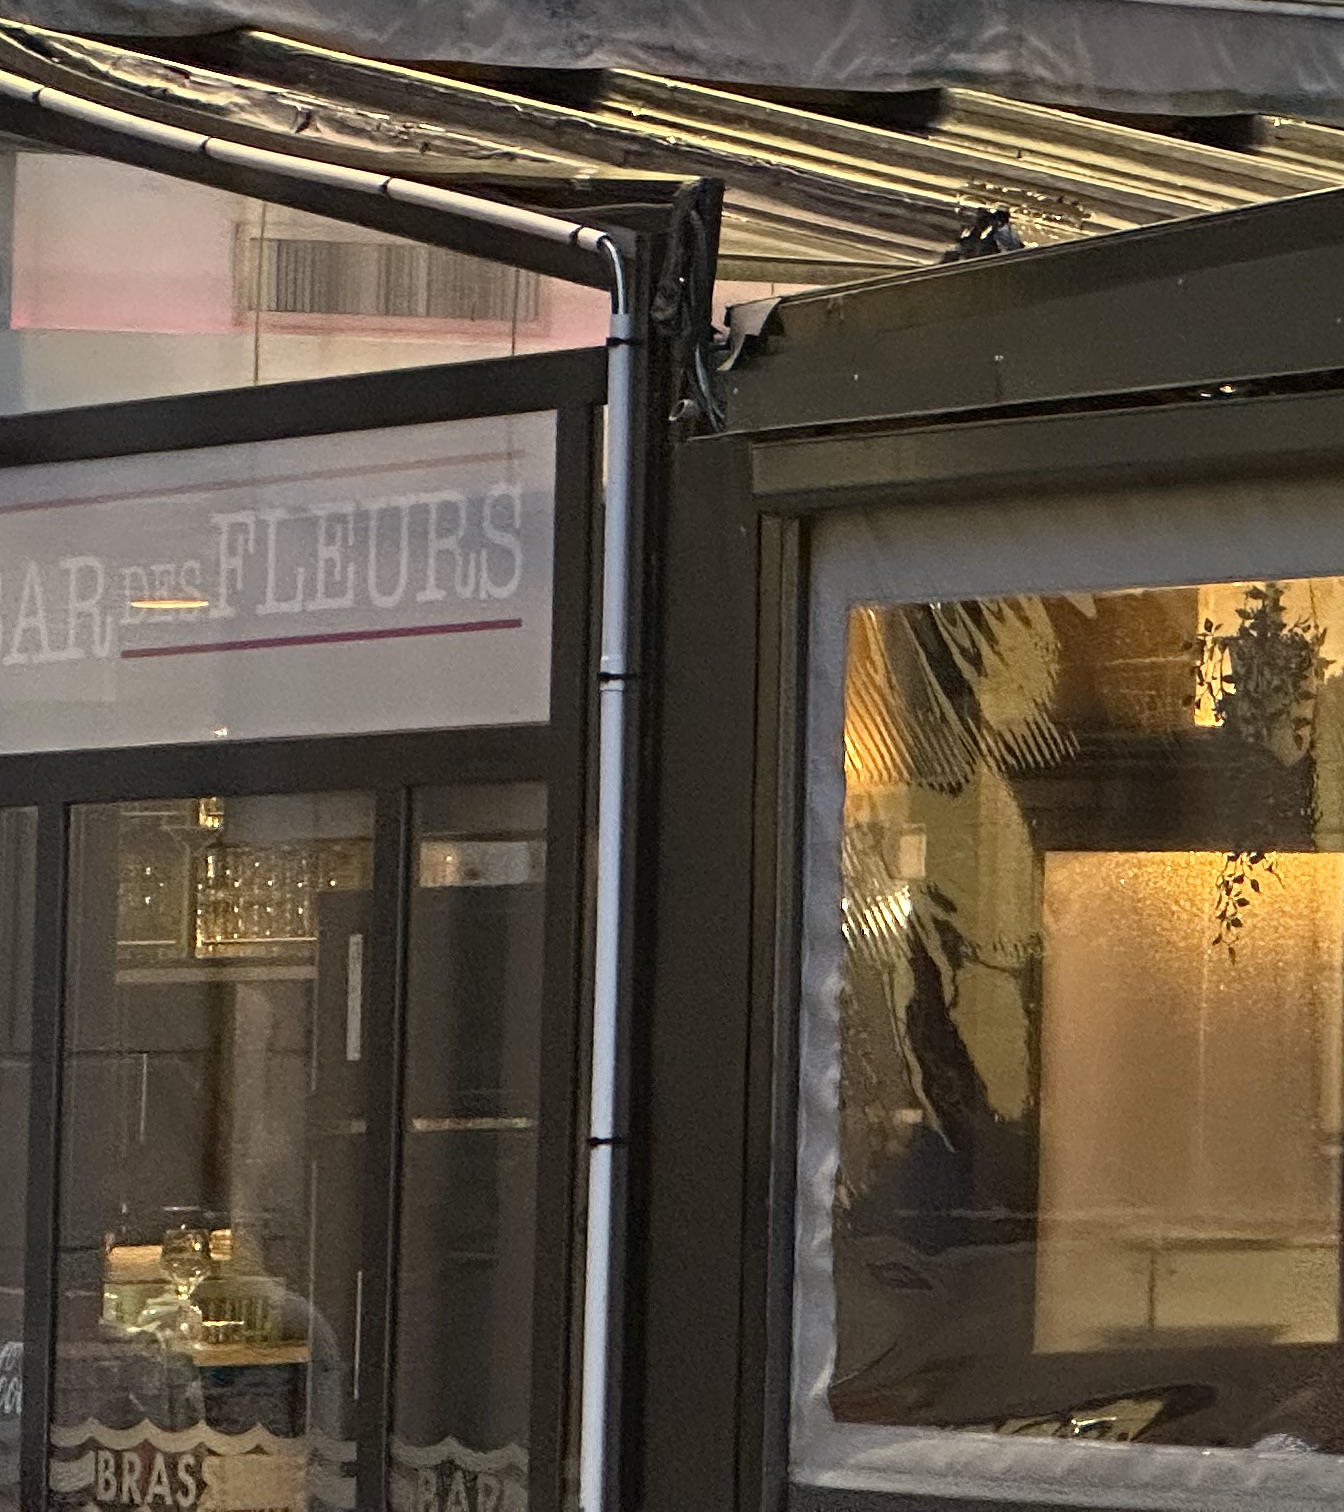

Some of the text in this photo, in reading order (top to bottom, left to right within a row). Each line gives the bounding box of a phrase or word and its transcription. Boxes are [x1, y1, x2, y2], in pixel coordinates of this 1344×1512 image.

[0, 483, 525, 666] AR DES FLEURS
